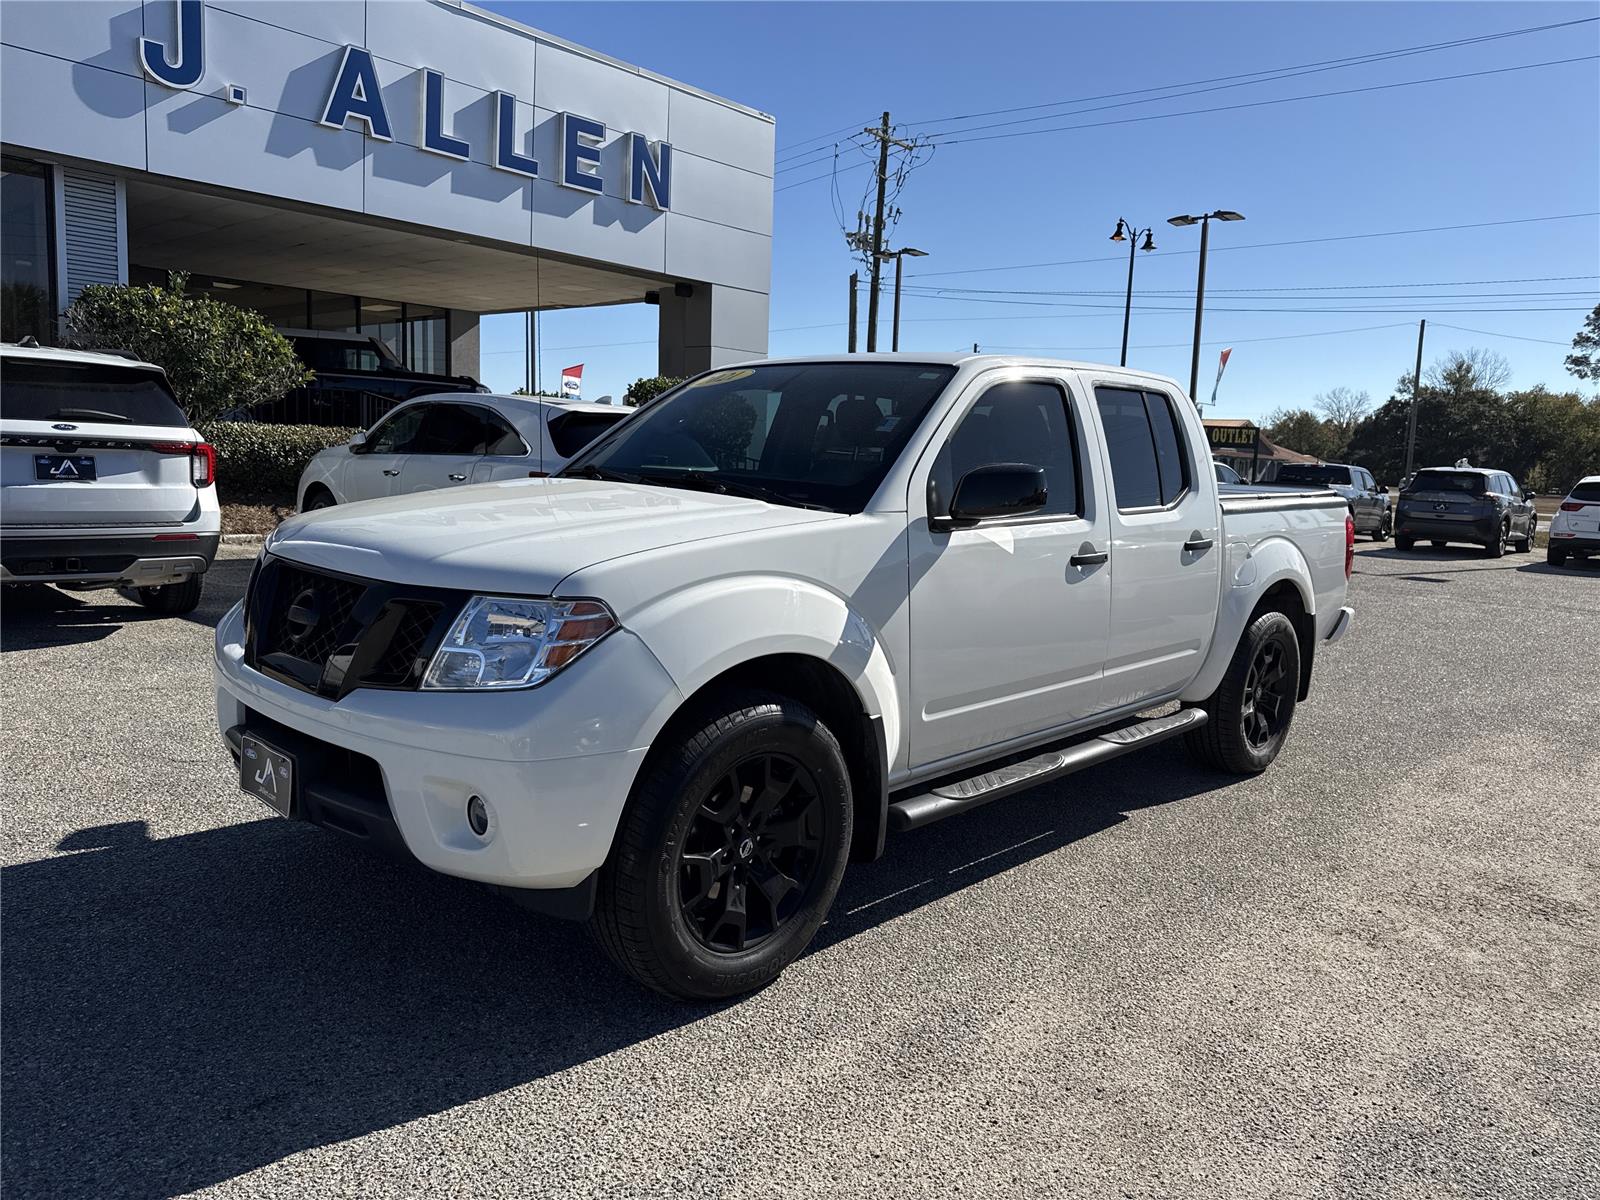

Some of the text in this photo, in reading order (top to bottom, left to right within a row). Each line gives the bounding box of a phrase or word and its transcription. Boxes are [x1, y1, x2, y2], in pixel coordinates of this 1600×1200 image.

[138, 0, 672, 211] J. ALLEN
[1212, 428, 1256, 444] OUTLET
